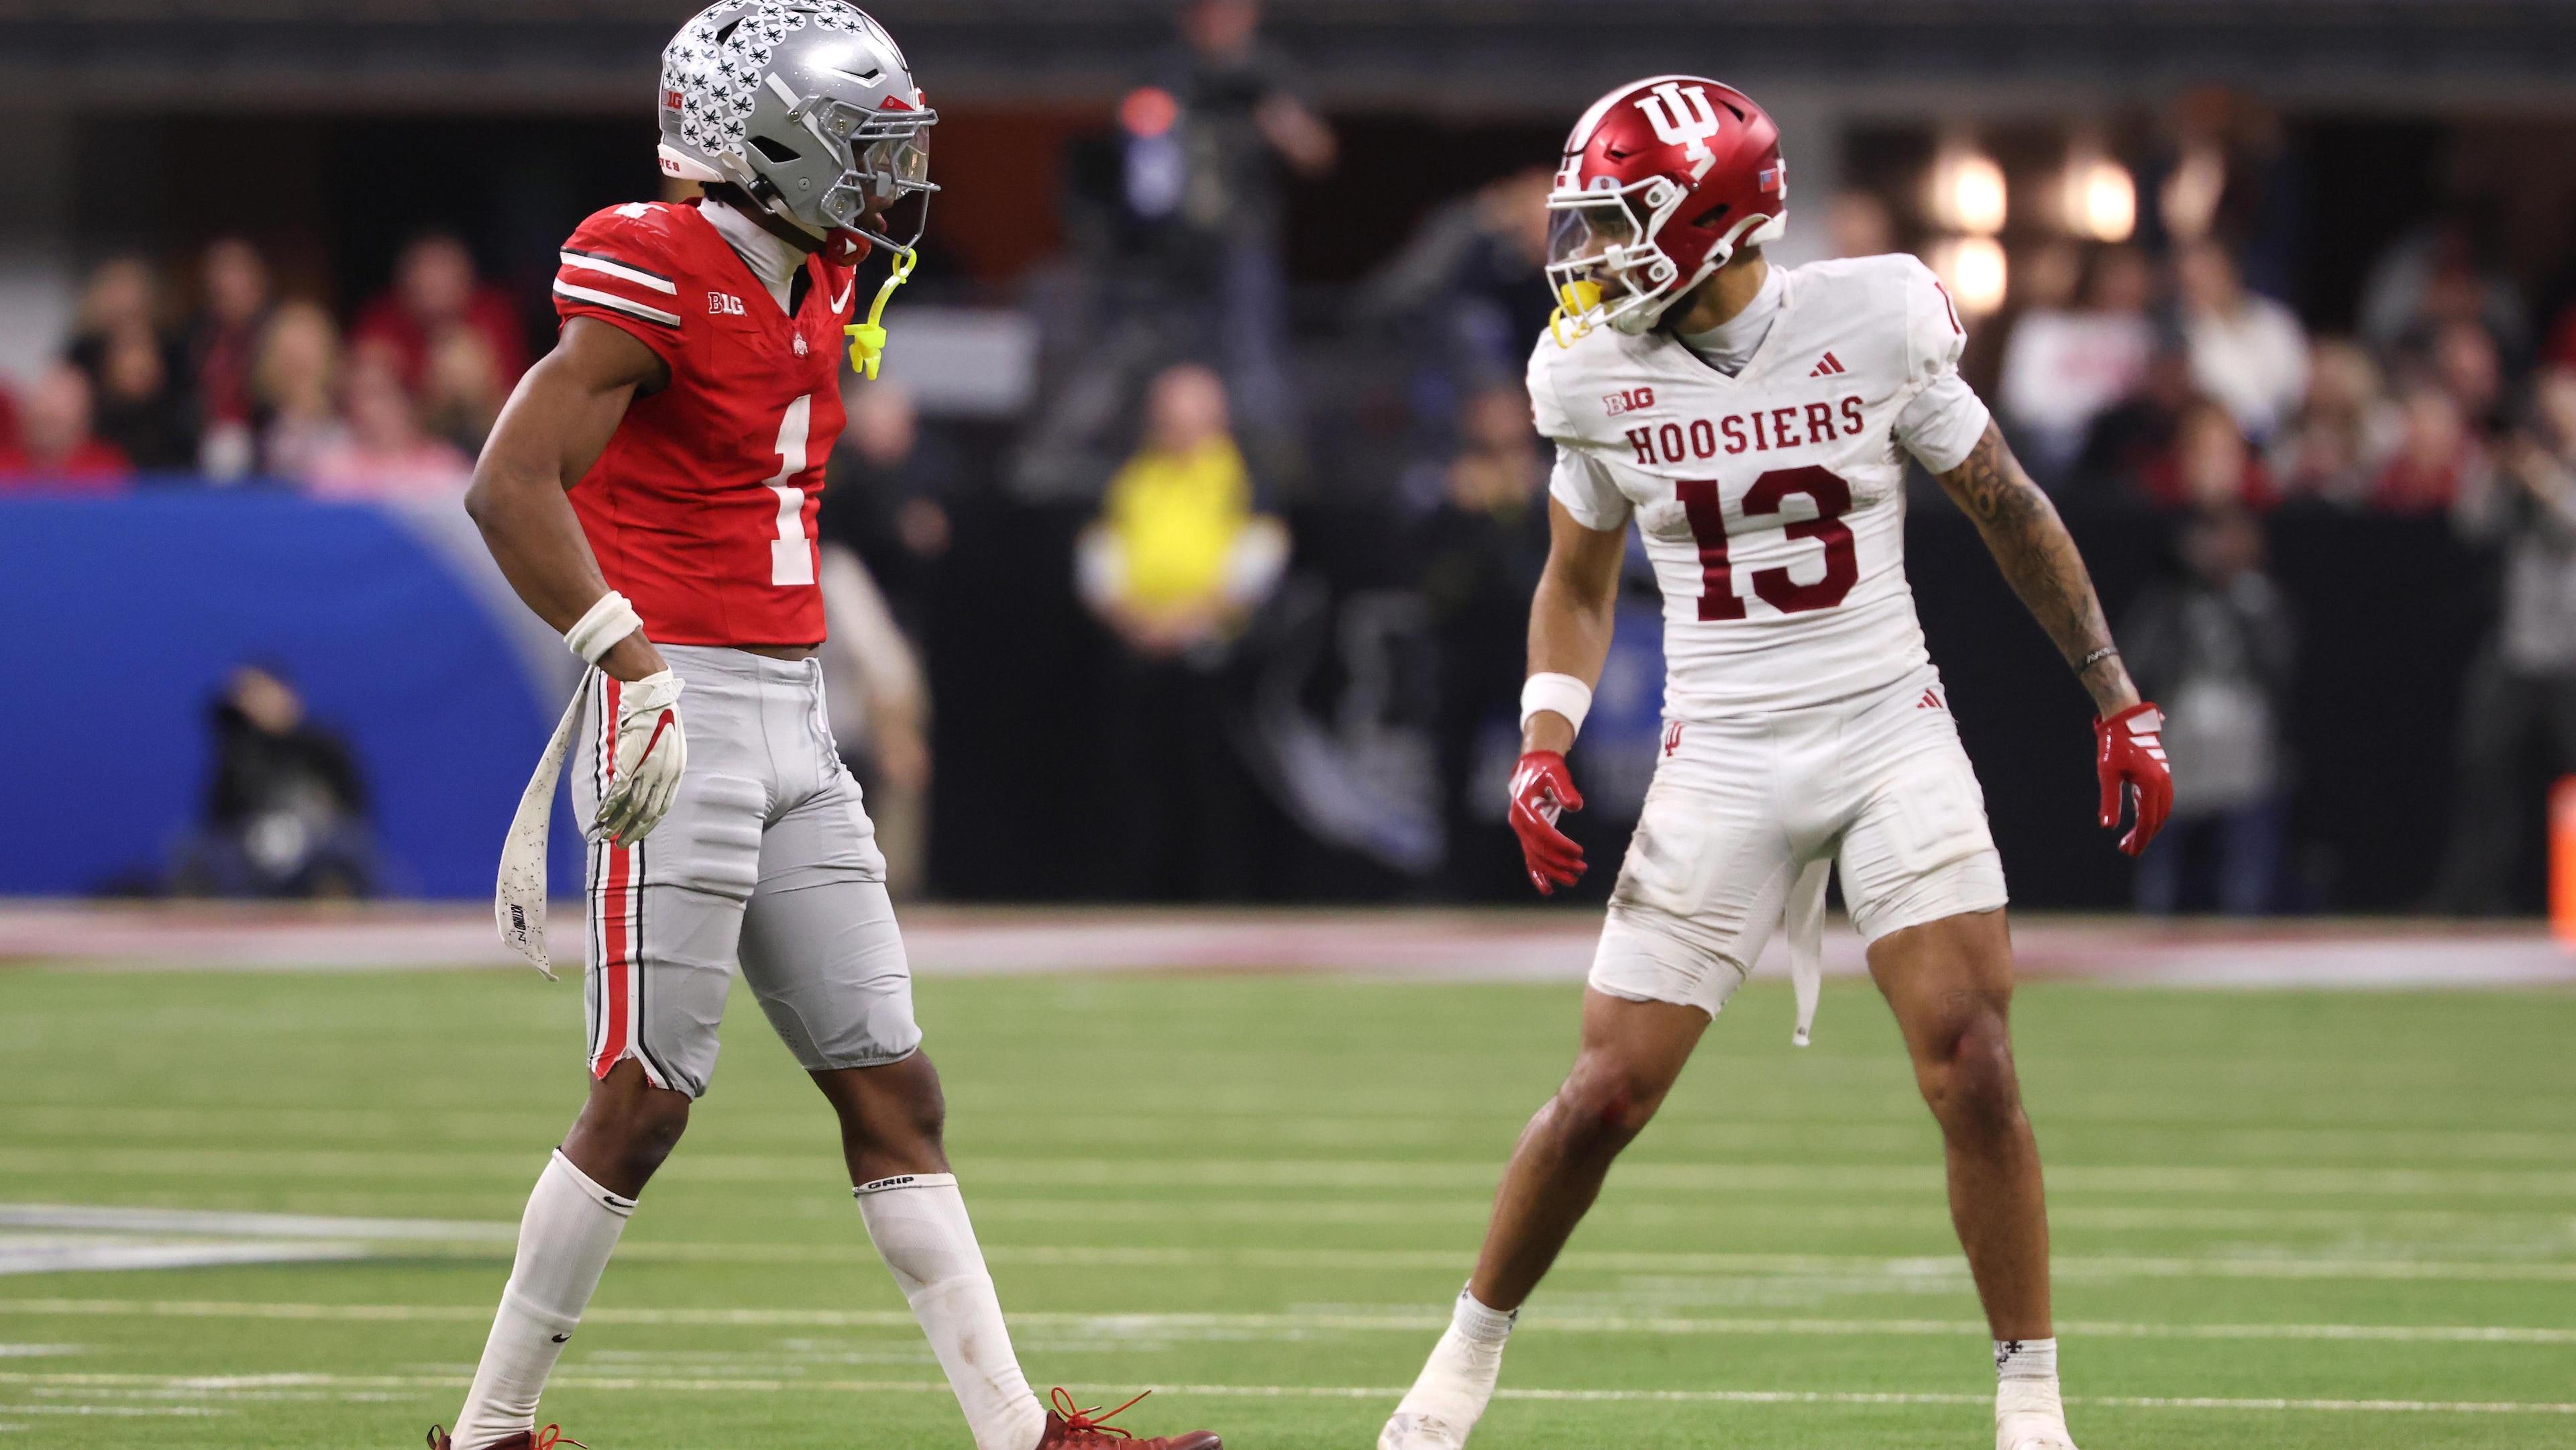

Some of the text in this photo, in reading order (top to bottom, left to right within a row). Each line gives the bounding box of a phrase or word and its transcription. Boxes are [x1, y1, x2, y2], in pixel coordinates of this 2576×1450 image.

[1626, 397, 1864, 464] HOOSIERS
[761, 394, 815, 585] 1
[1676, 465, 1858, 621] 13
[868, 1176, 914, 1188] GRIP
